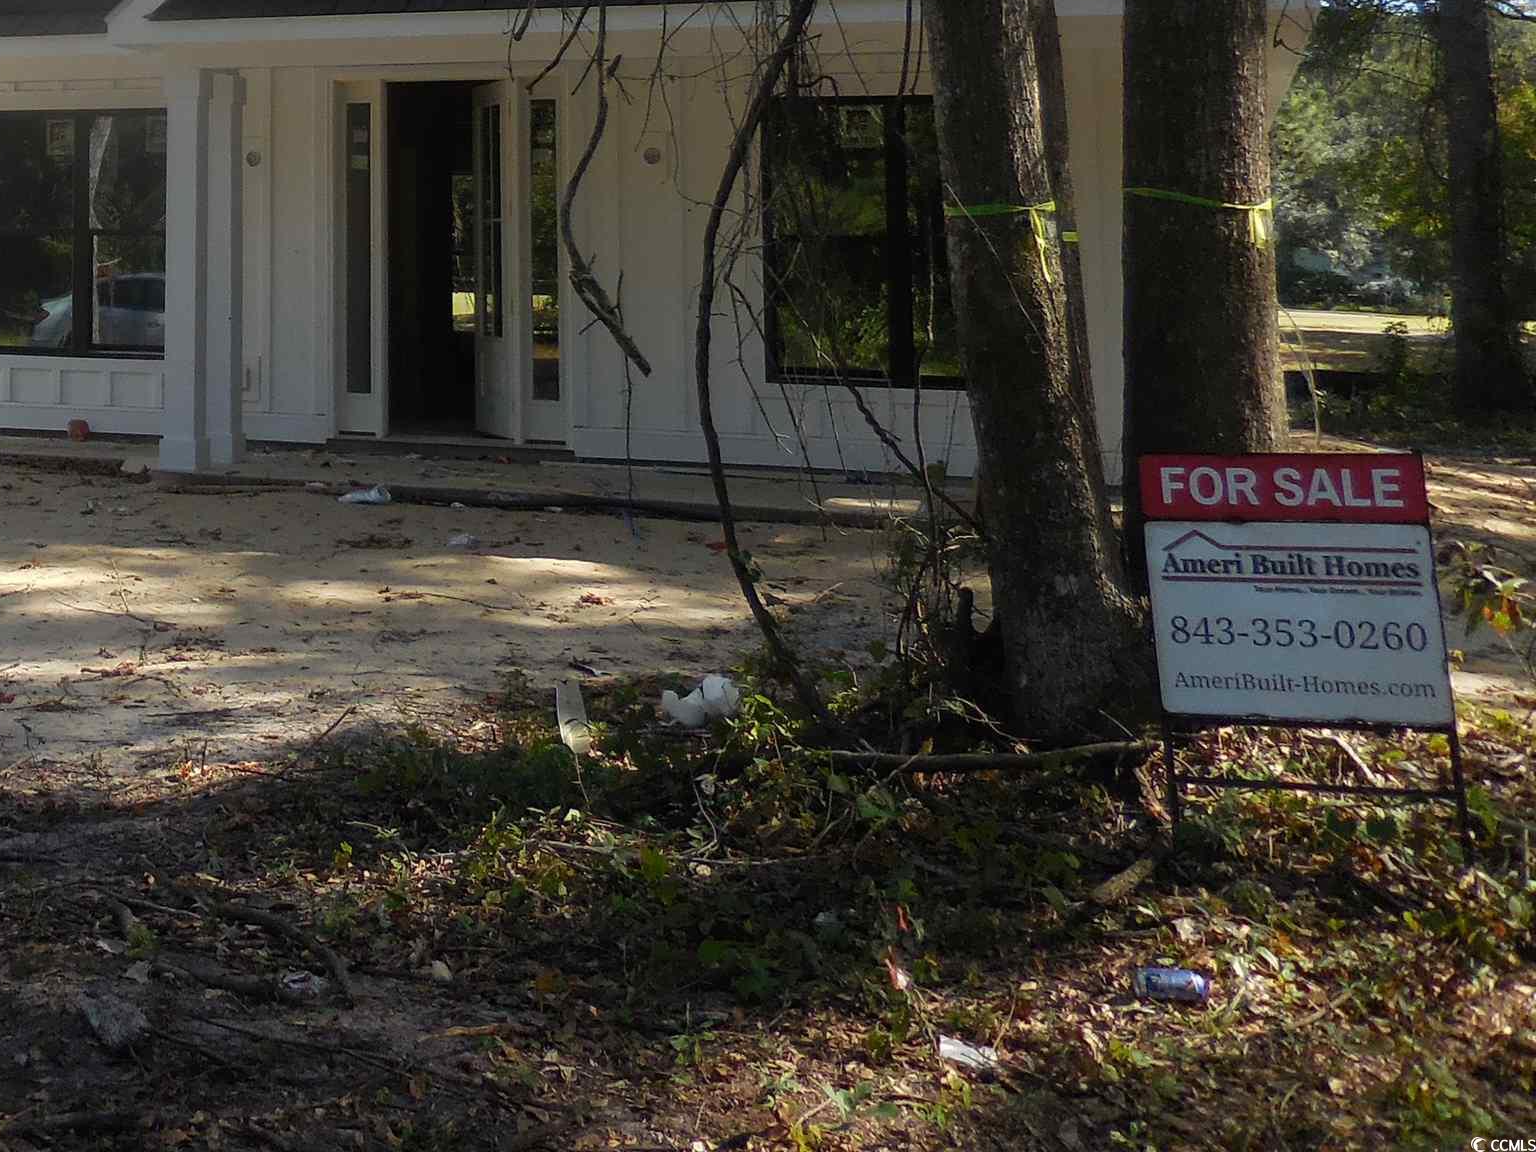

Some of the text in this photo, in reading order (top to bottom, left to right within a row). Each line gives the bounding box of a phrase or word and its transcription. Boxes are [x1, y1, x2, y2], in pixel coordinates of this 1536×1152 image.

[1159, 467, 1405, 509] FOR SALE
[1163, 552, 1420, 579] Ameri Built Homes
[1170, 615, 1428, 652] 843-353-0260
[1175, 671, 1437, 698] AmeriBuilt-Homes.com
